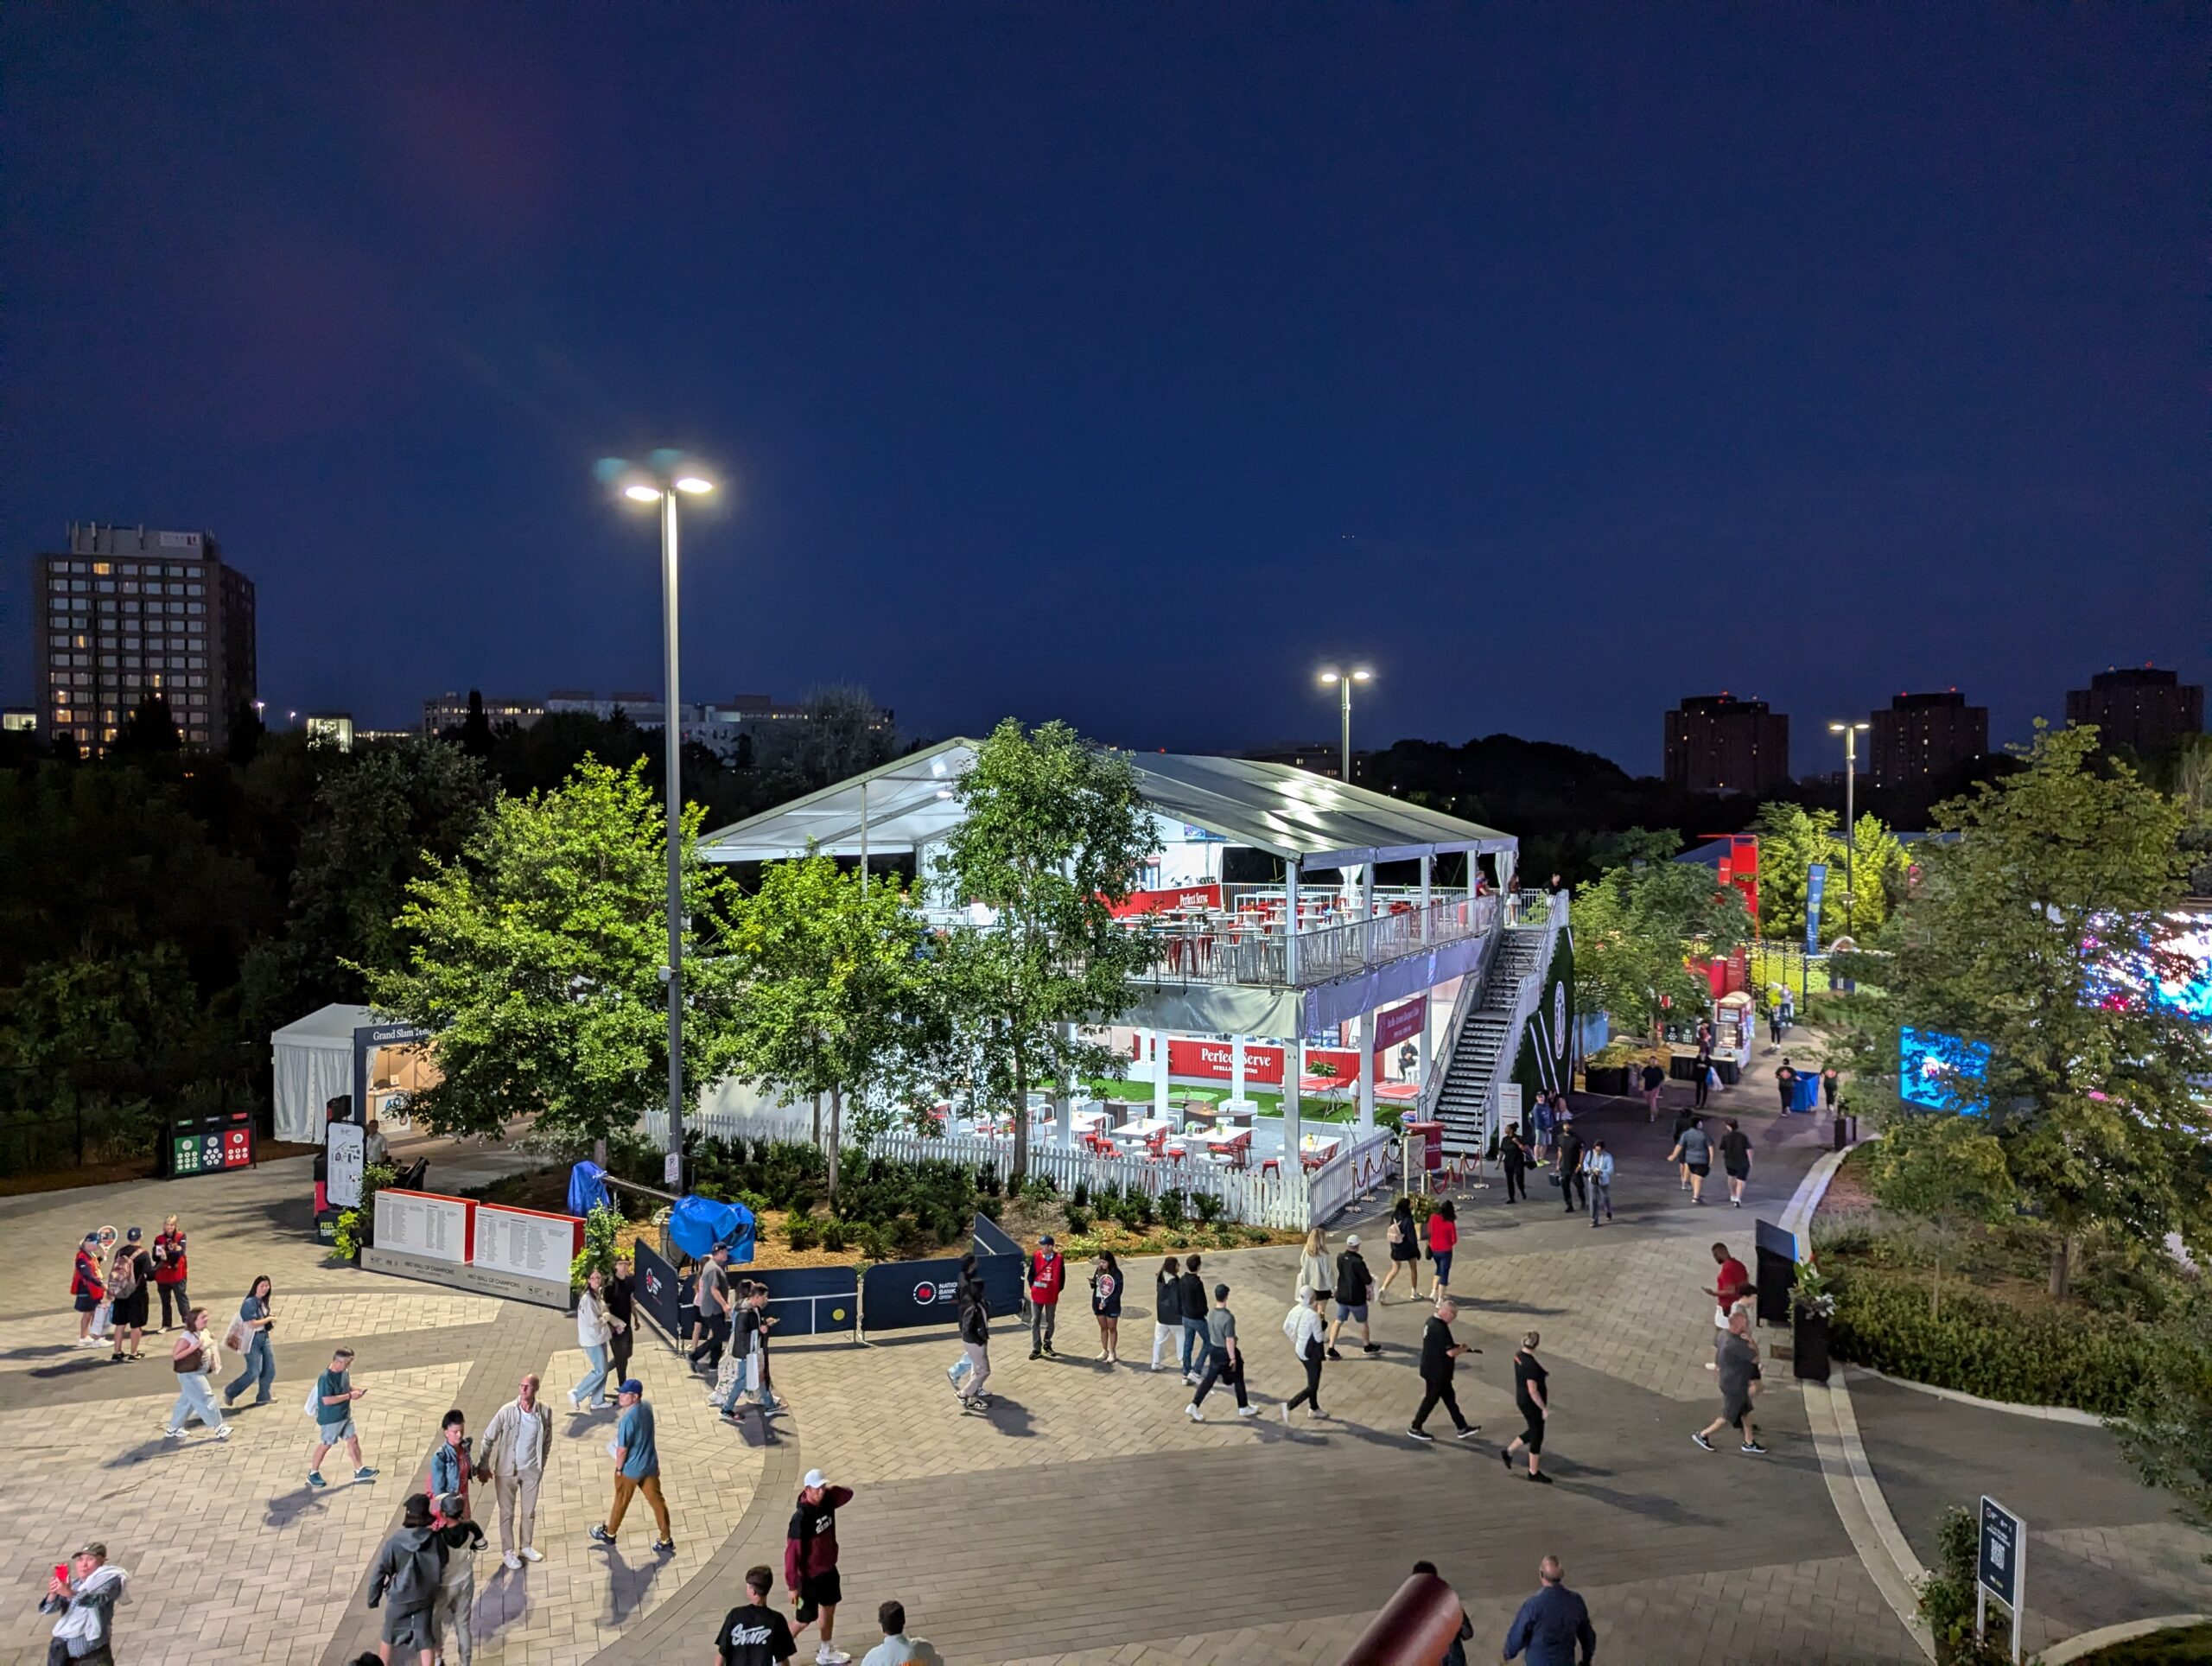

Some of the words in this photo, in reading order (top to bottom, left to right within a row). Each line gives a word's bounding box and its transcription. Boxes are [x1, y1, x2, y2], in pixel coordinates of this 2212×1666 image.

[373, 1029, 396, 1040] Grand
[396, 1028, 414, 1038] Slam
[1202, 1048, 1233, 1063] Perfec
